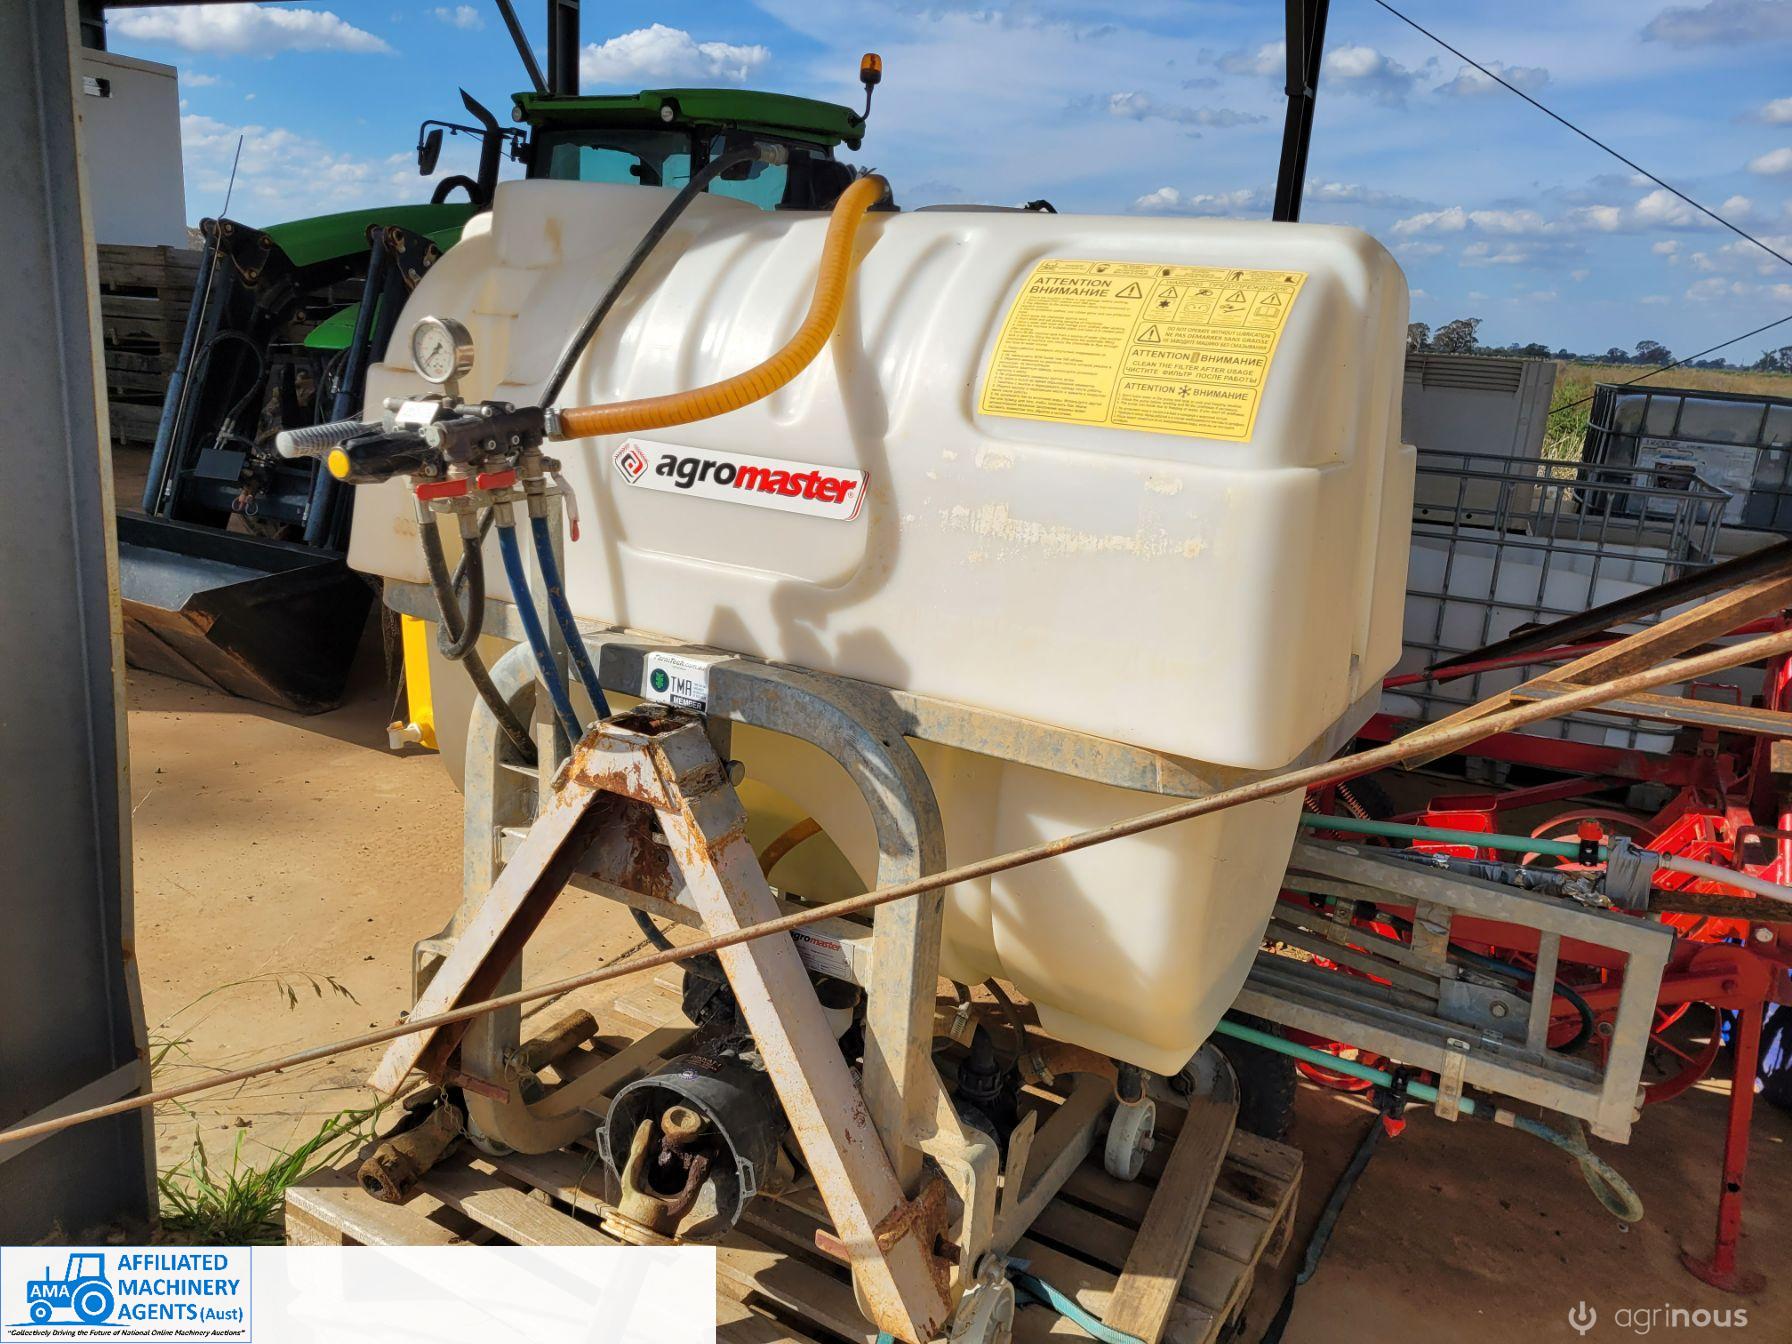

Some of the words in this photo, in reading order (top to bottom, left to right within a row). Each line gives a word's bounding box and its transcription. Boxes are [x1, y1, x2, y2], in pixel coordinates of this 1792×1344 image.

[1034, 278, 1112, 288] ATTENTION
[1029, 286, 1110, 298] ВНИМАНИЕ
[1132, 349, 1191, 361] ATTENTION
[1200, 355, 1264, 367] ВНИМАНИЕ
[1125, 367, 1159, 375] ЧИСТИТЕ
[1224, 375, 1258, 384] РАБОТЫ
[1124, 382, 1175, 393] ATTENTION
[1193, 388, 1249, 400] ВНИМАНИЕ
[655, 454, 857, 504] agromaster
[671, 676, 692, 696] TMA
[673, 697, 702, 710] MEMBER
